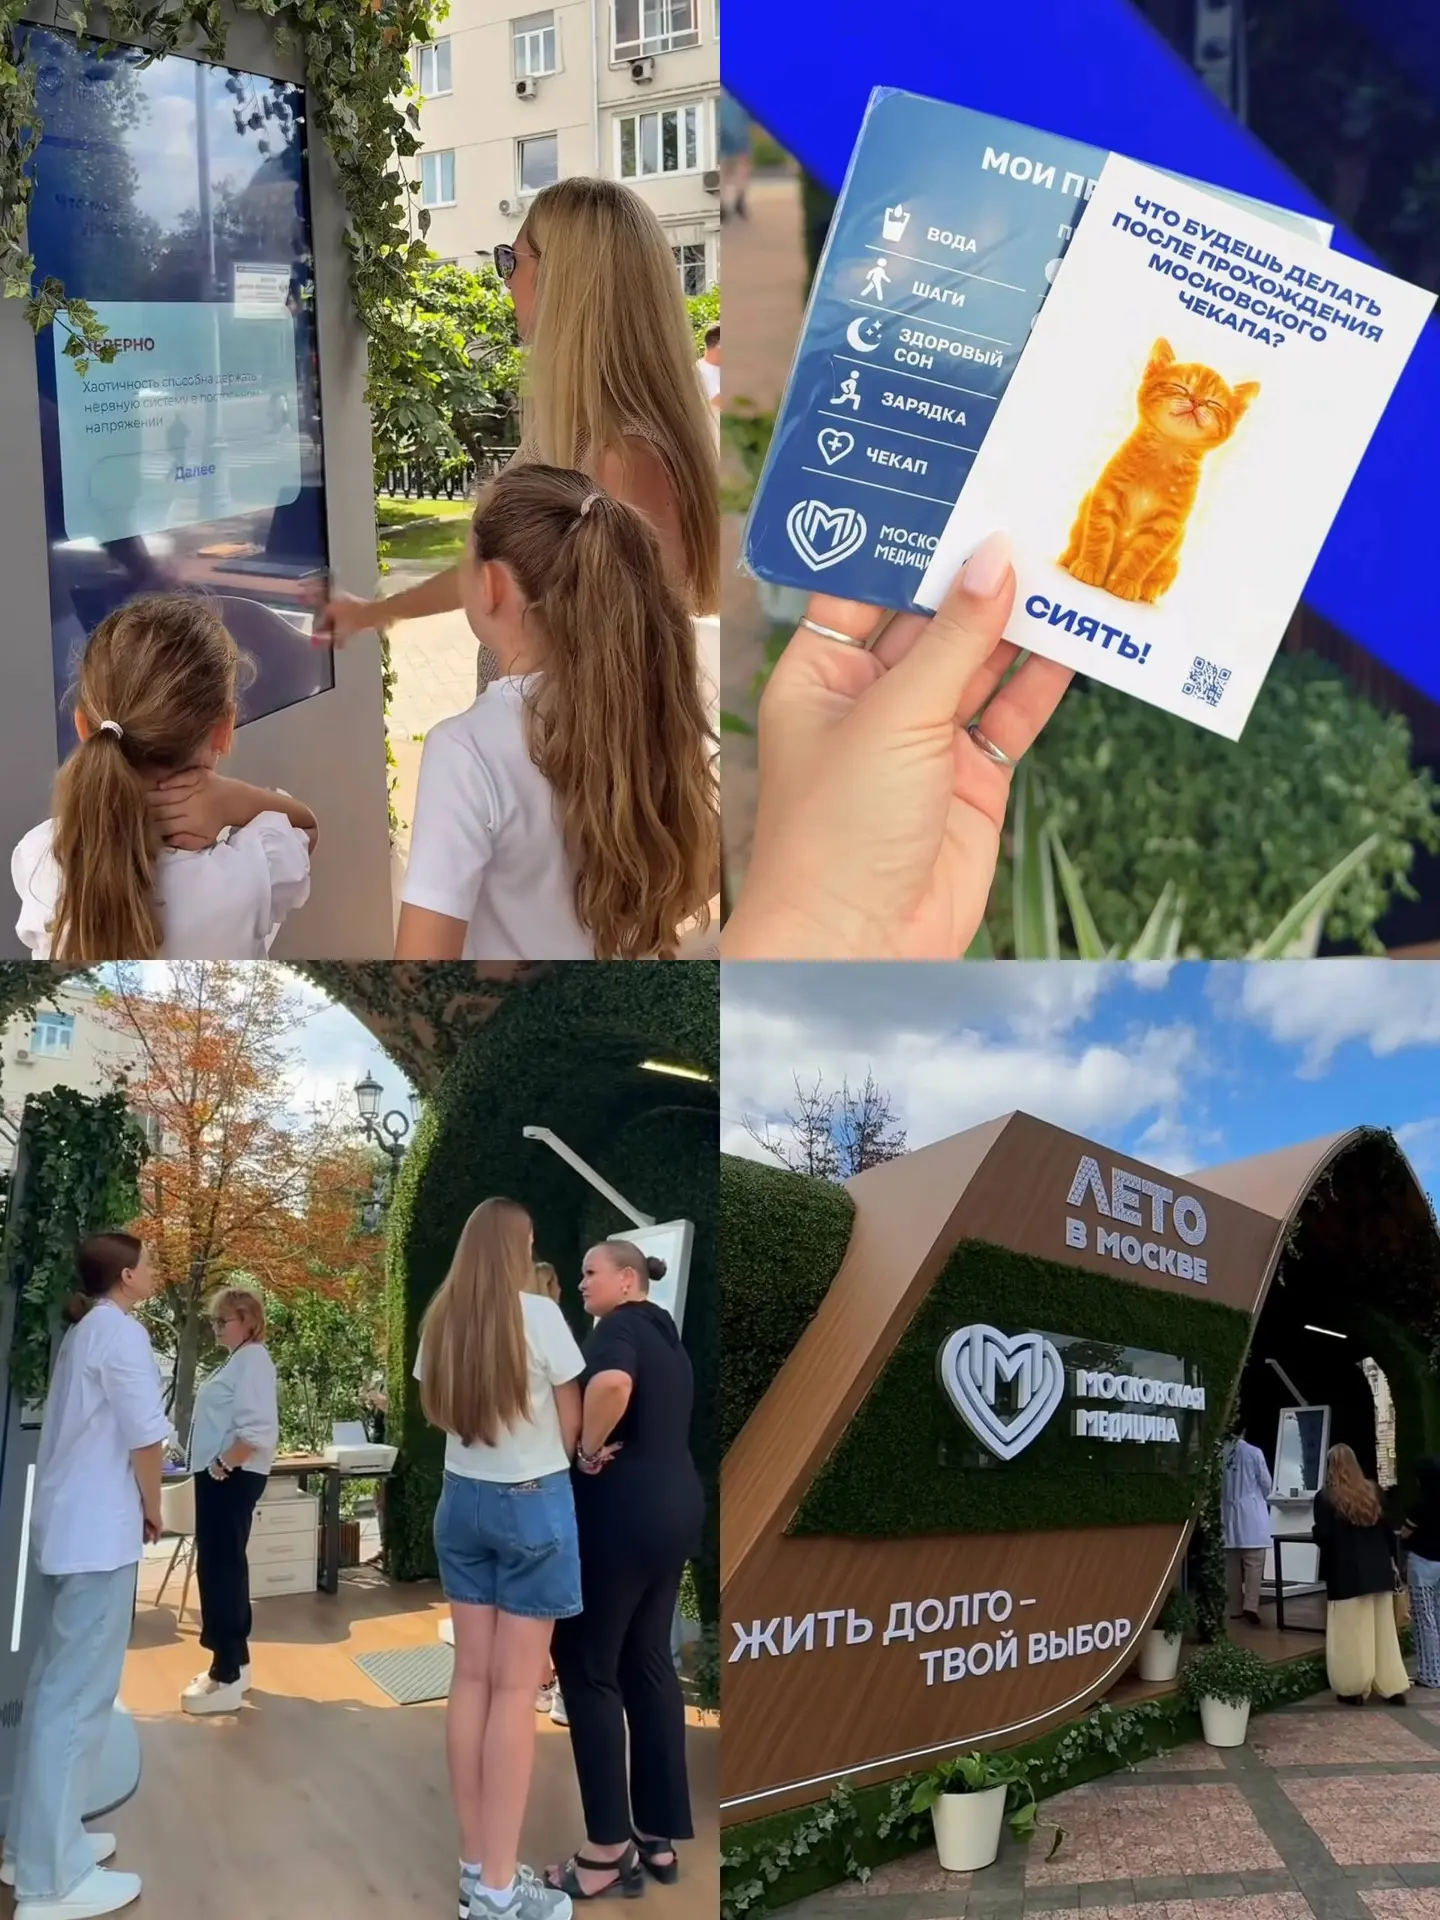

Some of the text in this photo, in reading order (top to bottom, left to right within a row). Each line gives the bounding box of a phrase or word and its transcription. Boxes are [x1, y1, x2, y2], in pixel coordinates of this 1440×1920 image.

[981, 147, 1057, 190] МОИ
[926, 226, 977, 253] ВОДА
[1134, 195, 1382, 317] ЧТО БУДЕШЬ ДЕЛАТЬ
[912, 280, 966, 307] ШАГИ
[1112, 211, 1384, 343] ПОСЛЕ ПРОХОЖДЕНИЯ
[1148, 253, 1328, 343] МОСКОВСКОГО
[1178, 290, 1286, 348] ЧЕКАПА?
[85, 337, 155, 353] ЕВЕРНО
[894, 347, 933, 370] СОН
[899, 328, 1004, 368] ЗДОРОВЫЙ
[82, 372, 258, 393] Хаотичность способна держать
[84, 401, 140, 415] нервную
[143, 397, 188, 409] систему
[85, 417, 163, 434] напряжении
[881, 391, 967, 427] ЗАРЯДКА
[175, 463, 216, 481] Далее
[866, 446, 929, 475] ЧЕКАП
[1025, 595, 1152, 665] СИЯТЬ!
[1066, 1155, 1207, 1246] ЛЕТО
[1066, 1216, 1208, 1284] В МОСКВЕ
[1075, 1368, 1206, 1411] МОСКОВСКАЯ
[1074, 1408, 1181, 1444] МЕДИЦИНА
[728, 1608, 873, 1663] ЖИТЬ
[883, 1590, 1012, 1646] ДОЛГО
[920, 1618, 1132, 1686] ТВОЙ ВЫБОР
